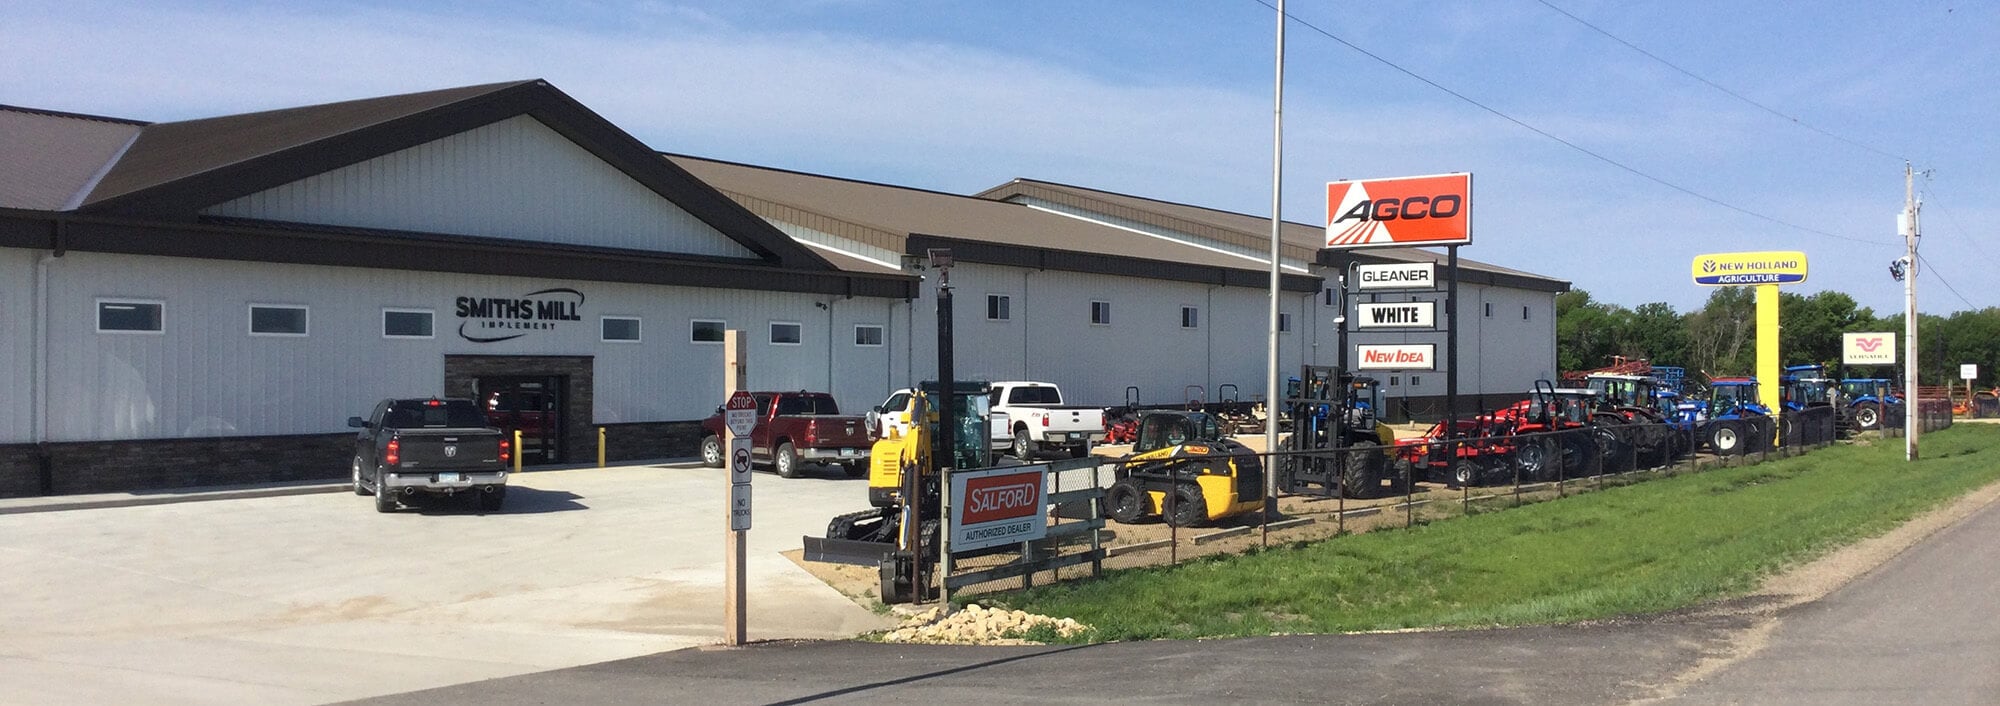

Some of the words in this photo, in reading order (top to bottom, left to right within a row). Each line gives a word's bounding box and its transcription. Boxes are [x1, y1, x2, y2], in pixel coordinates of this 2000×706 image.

[1333, 194, 1462, 224] AGCO
[1719, 262, 1744, 271] NEW
[1746, 260, 1798, 270] HOLLAND
[1362, 269, 1429, 282] GLEANER
[1718, 273, 1780, 284] AGRICULTURE
[455, 296, 534, 320] SMITHS
[537, 300, 581, 321] MILL
[1371, 306, 1419, 323] WHITE
[481, 321, 556, 330] IMPLEMENT
[731, 396, 752, 409] STOP
[737, 498, 746, 507] NO
[970, 483, 1036, 513] SALFORD
[965, 526, 1006, 541] AUTHORIZED
[1007, 522, 1032, 535] DEALER
